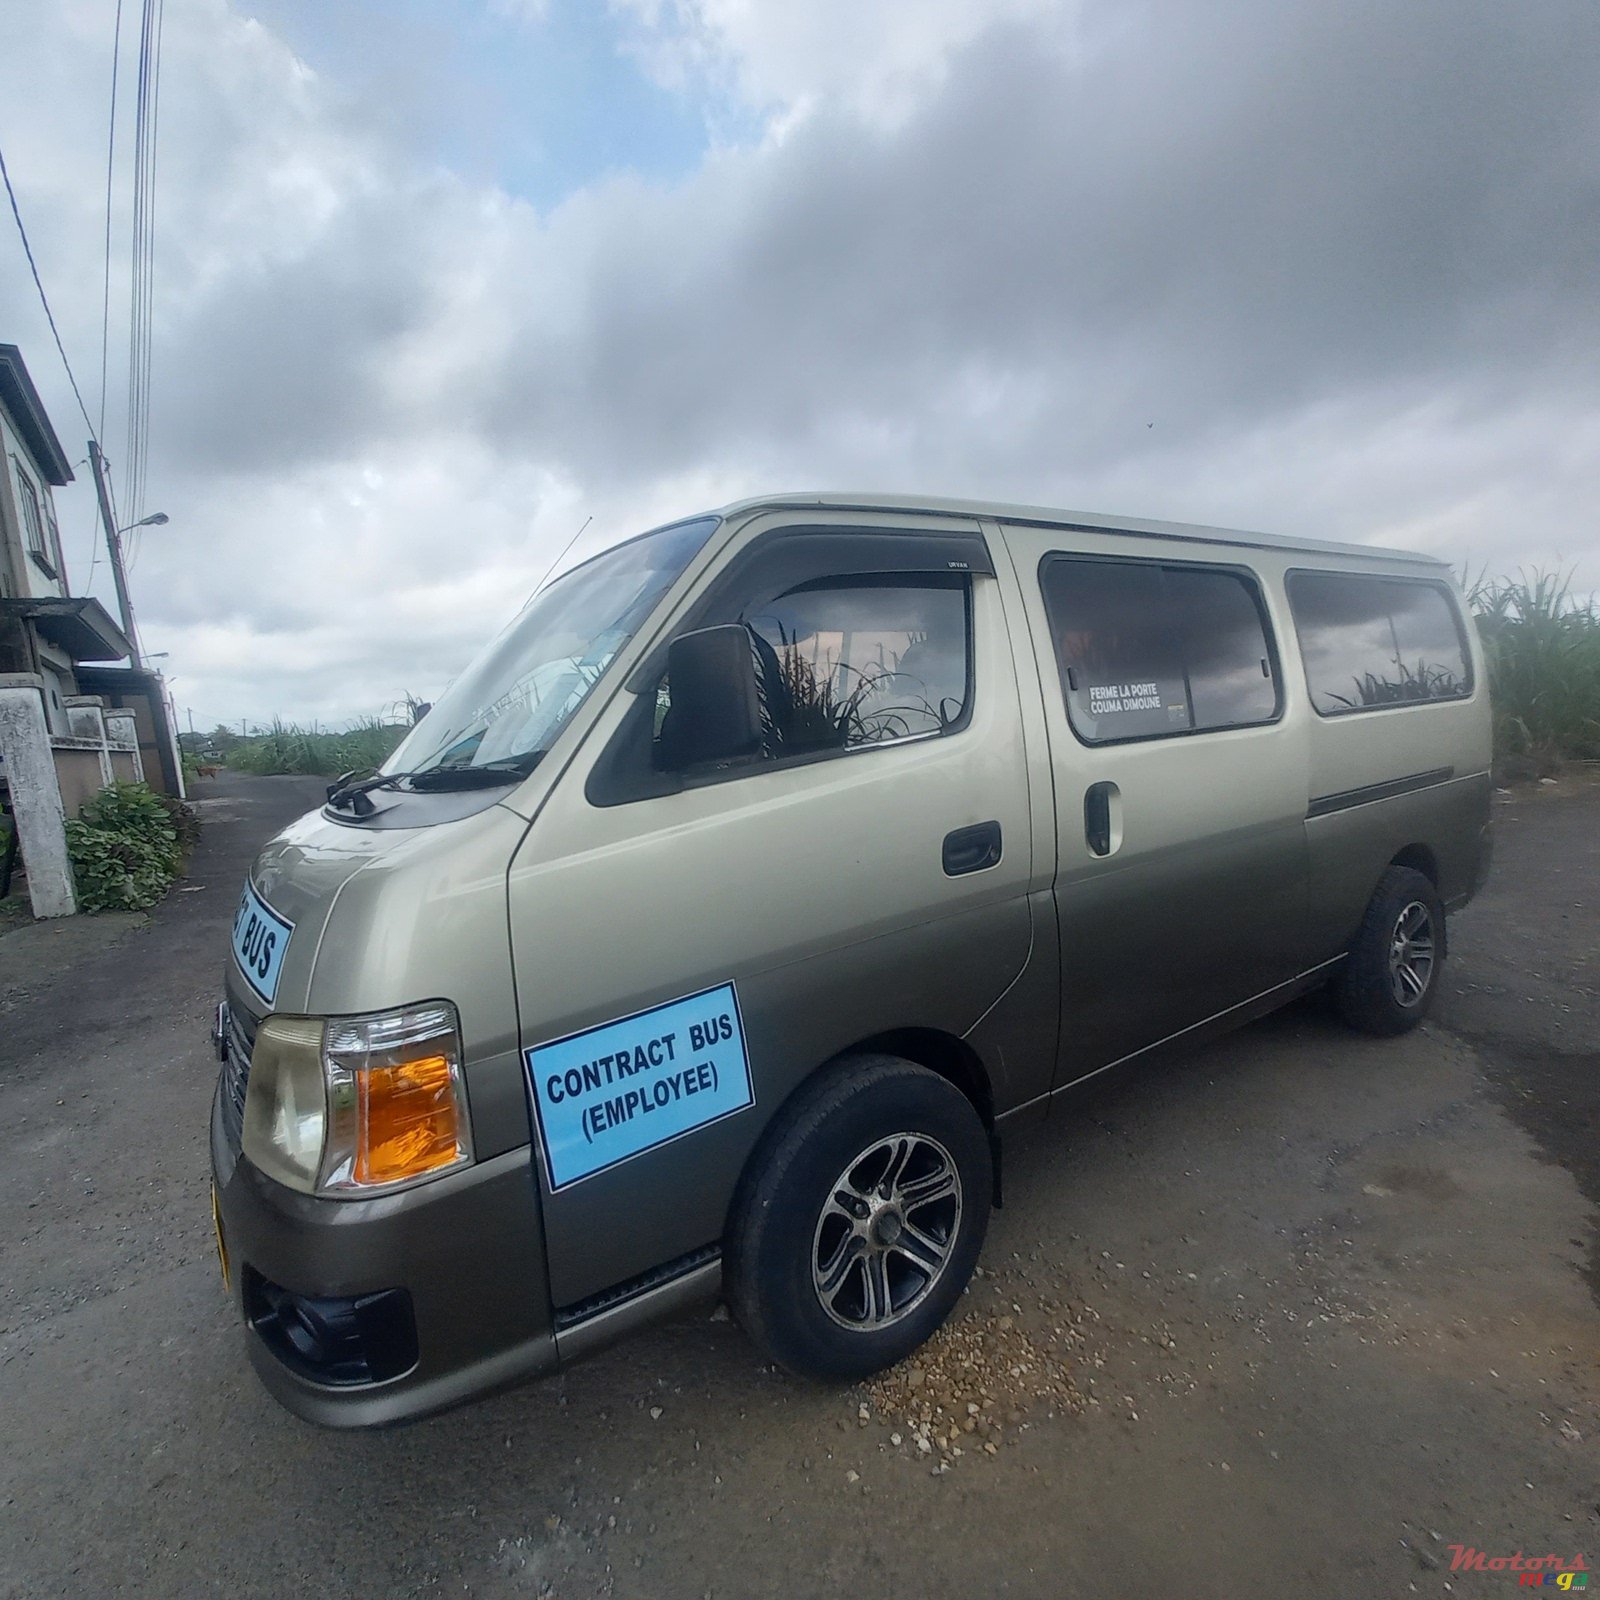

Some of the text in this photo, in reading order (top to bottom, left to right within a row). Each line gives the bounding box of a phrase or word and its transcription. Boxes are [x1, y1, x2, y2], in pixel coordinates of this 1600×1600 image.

[1089, 683, 1158, 699] FERME LA PORTE
[1090, 697, 1161, 714] COUMA DIMOUNE
[241, 911, 276, 979] BUS
[547, 1013, 733, 1104] CONTRACT BUS
[582, 1061, 719, 1144] (EMPLOYEE)
